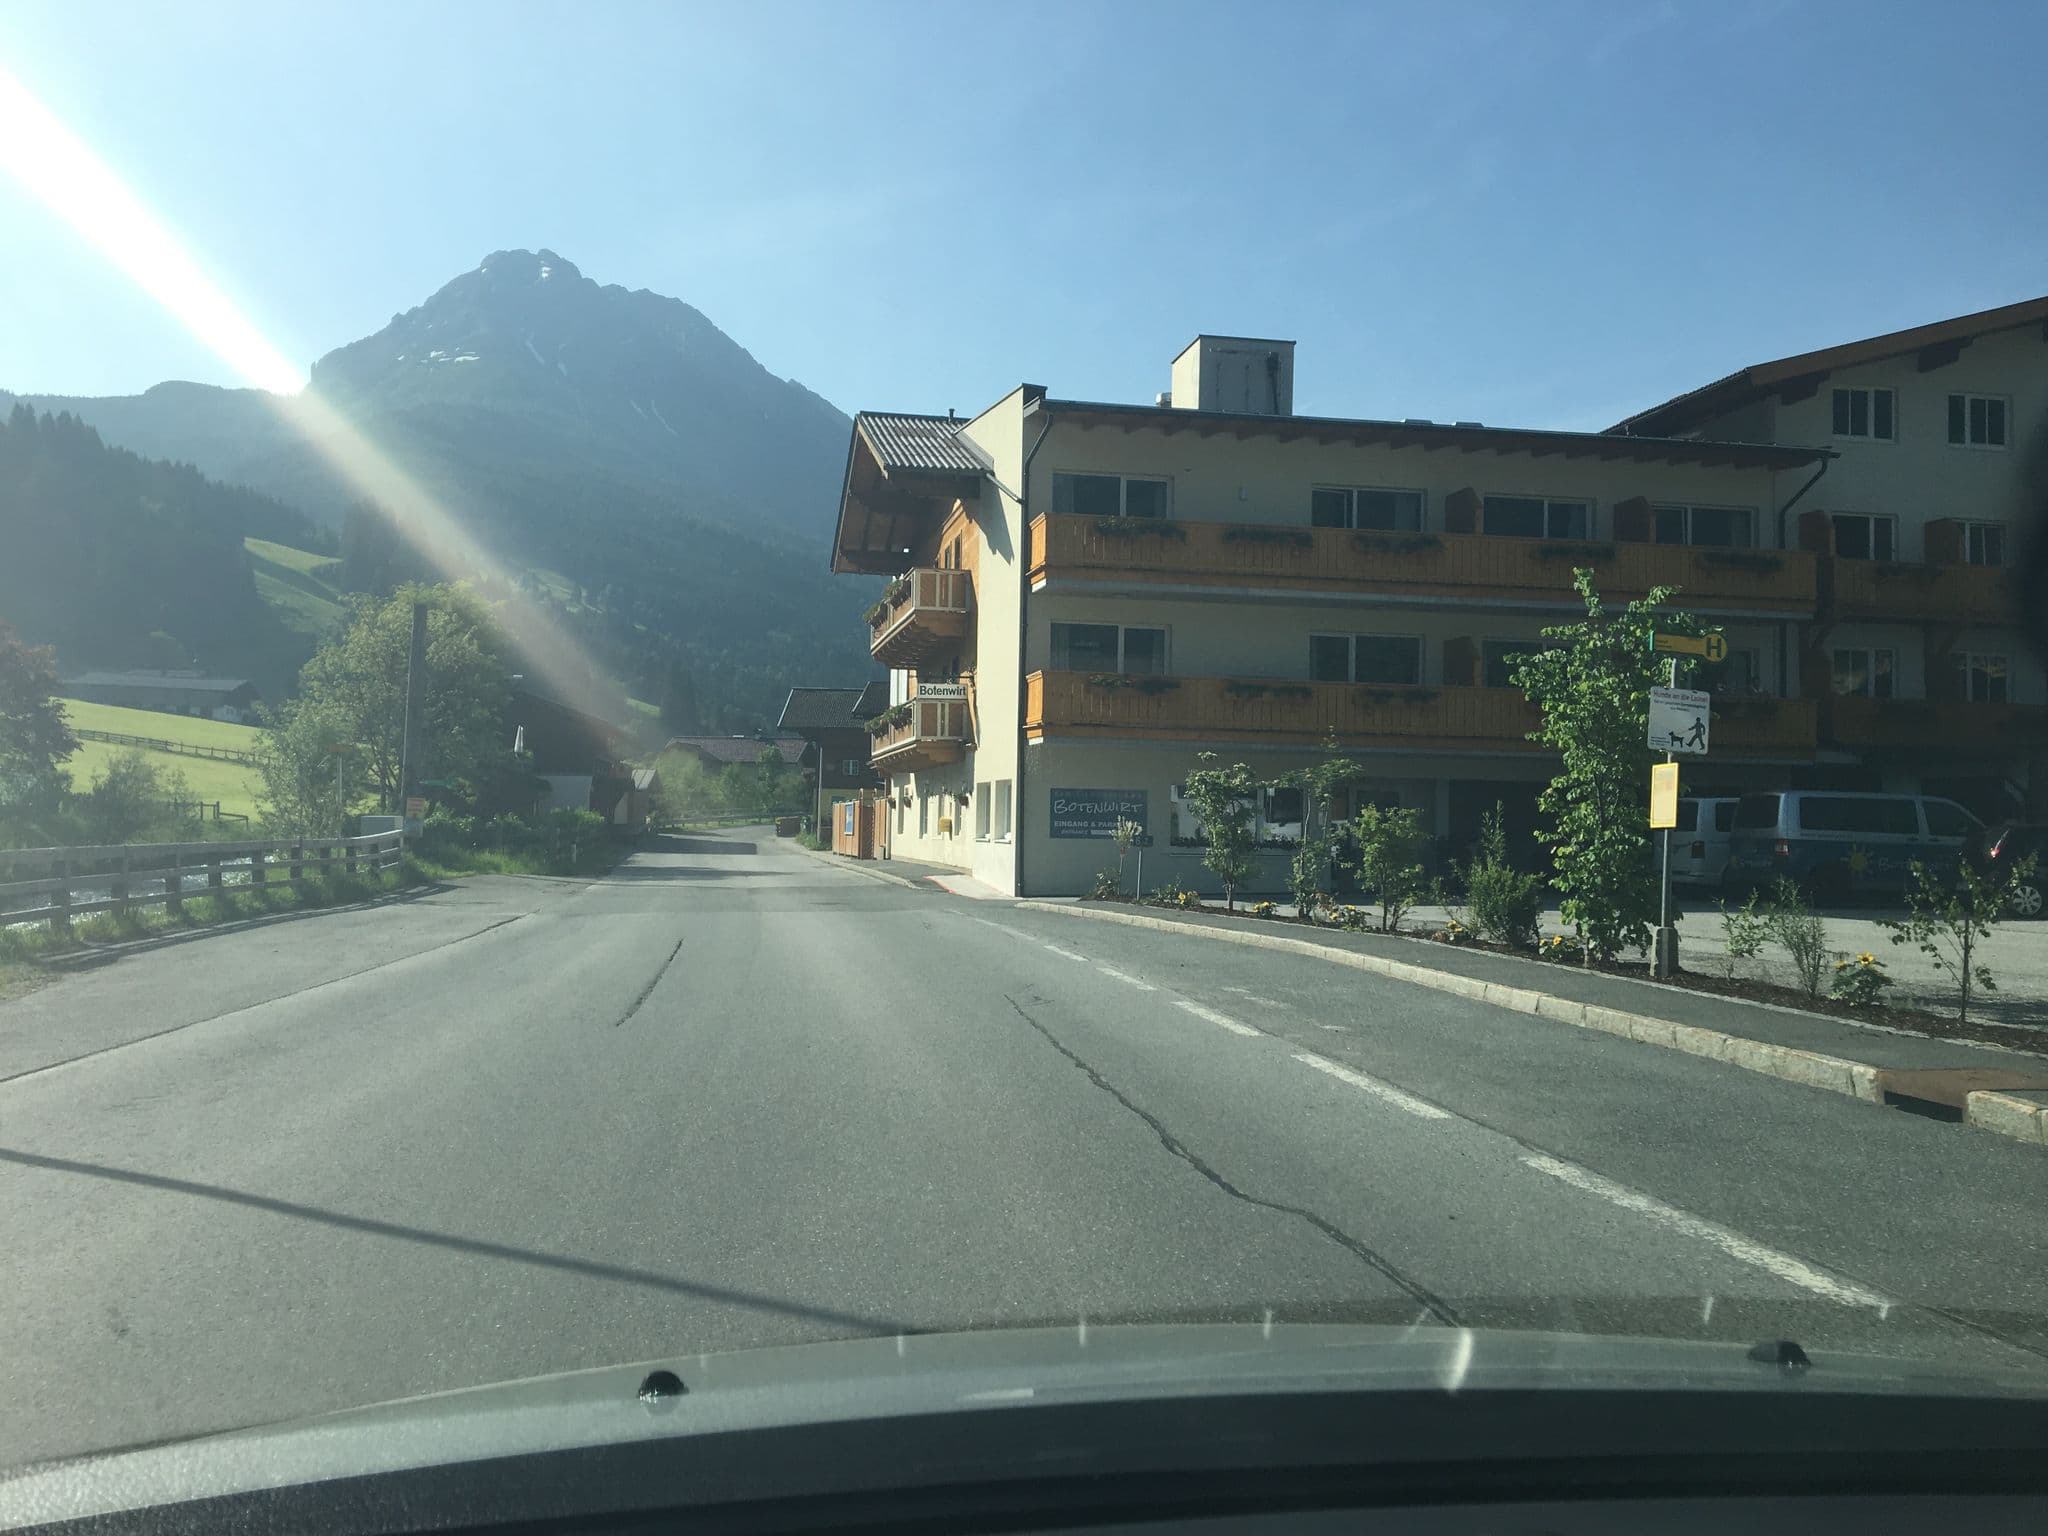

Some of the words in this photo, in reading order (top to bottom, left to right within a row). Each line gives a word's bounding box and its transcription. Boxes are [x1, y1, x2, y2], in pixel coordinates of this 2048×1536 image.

[1706, 636, 1722, 658] H
[919, 685, 967, 696] Botenwirt
[1054, 820, 1089, 828] EINGANG
